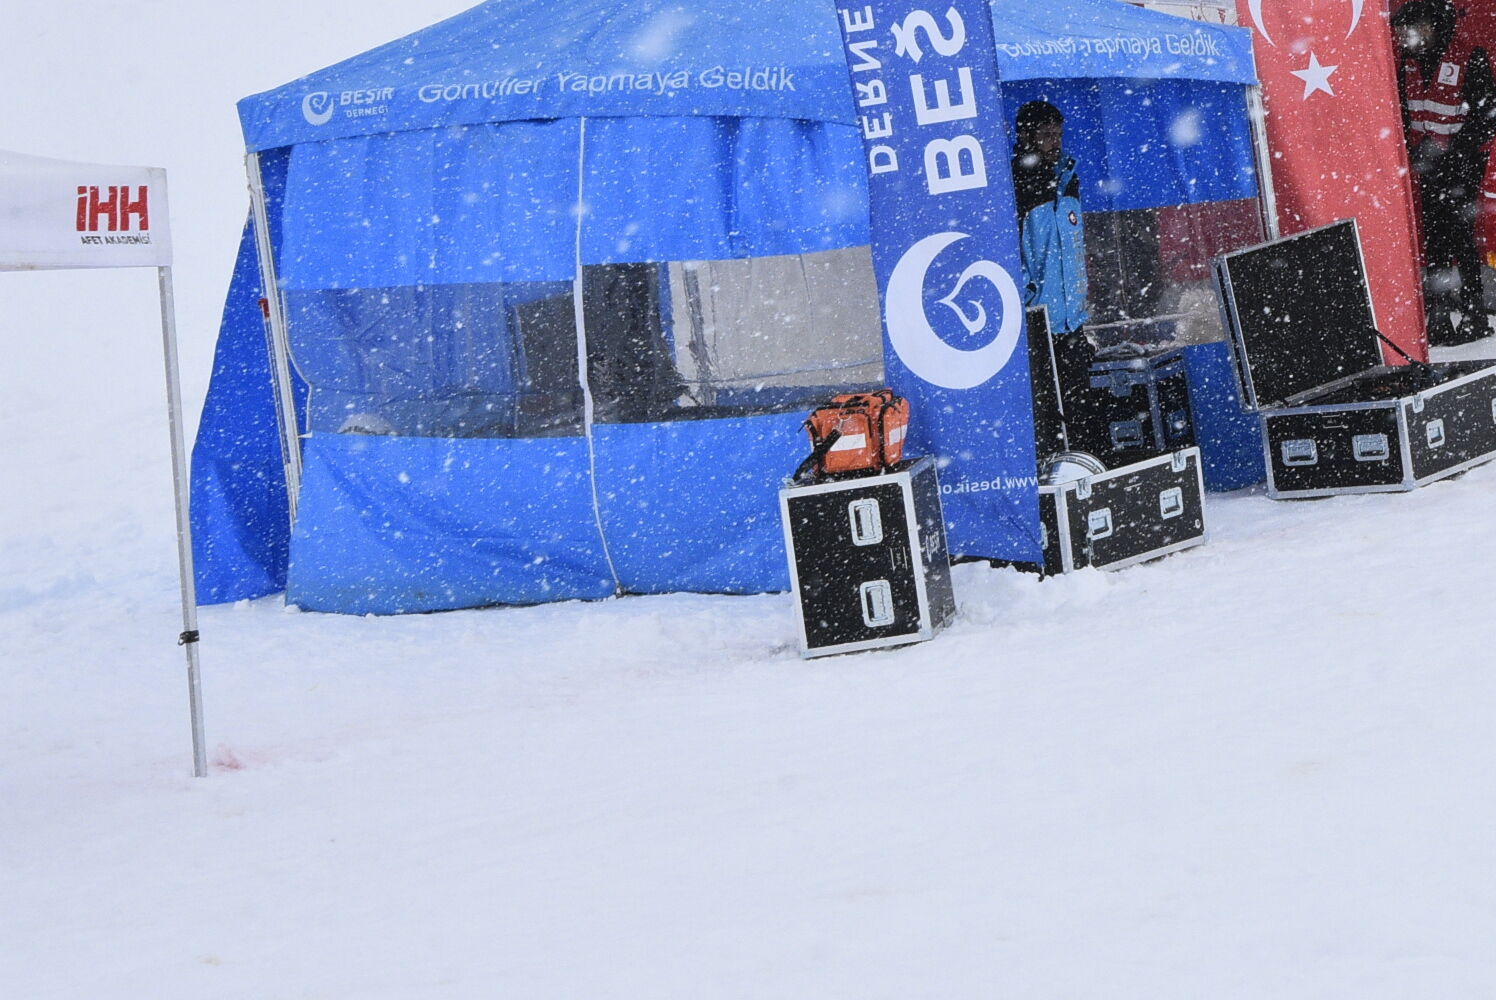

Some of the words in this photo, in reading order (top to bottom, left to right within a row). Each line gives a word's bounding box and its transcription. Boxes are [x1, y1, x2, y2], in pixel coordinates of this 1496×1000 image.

[1165, 33, 1221, 57] Geldik
[700, 65, 797, 92] Geldik
[81, 236, 103, 245] AFET
